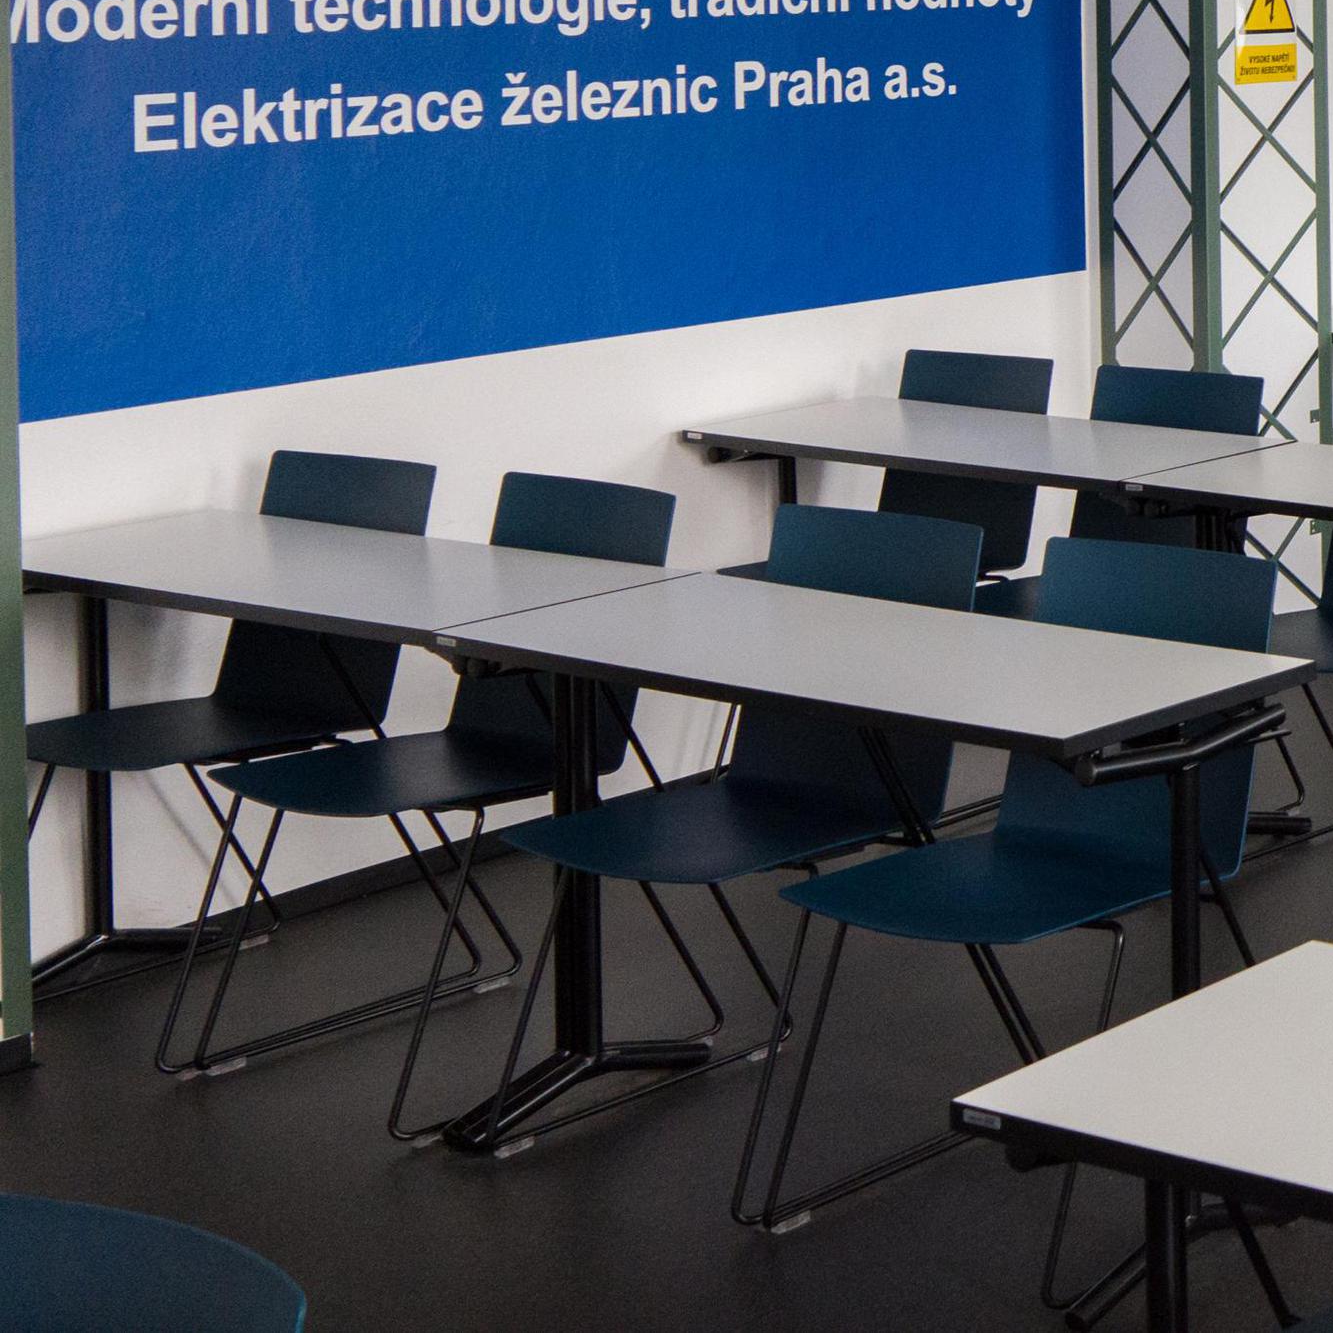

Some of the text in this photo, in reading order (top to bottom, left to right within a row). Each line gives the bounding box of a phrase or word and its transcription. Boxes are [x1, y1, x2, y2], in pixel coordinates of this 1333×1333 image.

[134, 58, 957, 153] Elektrizace železnic Praha a.s.
